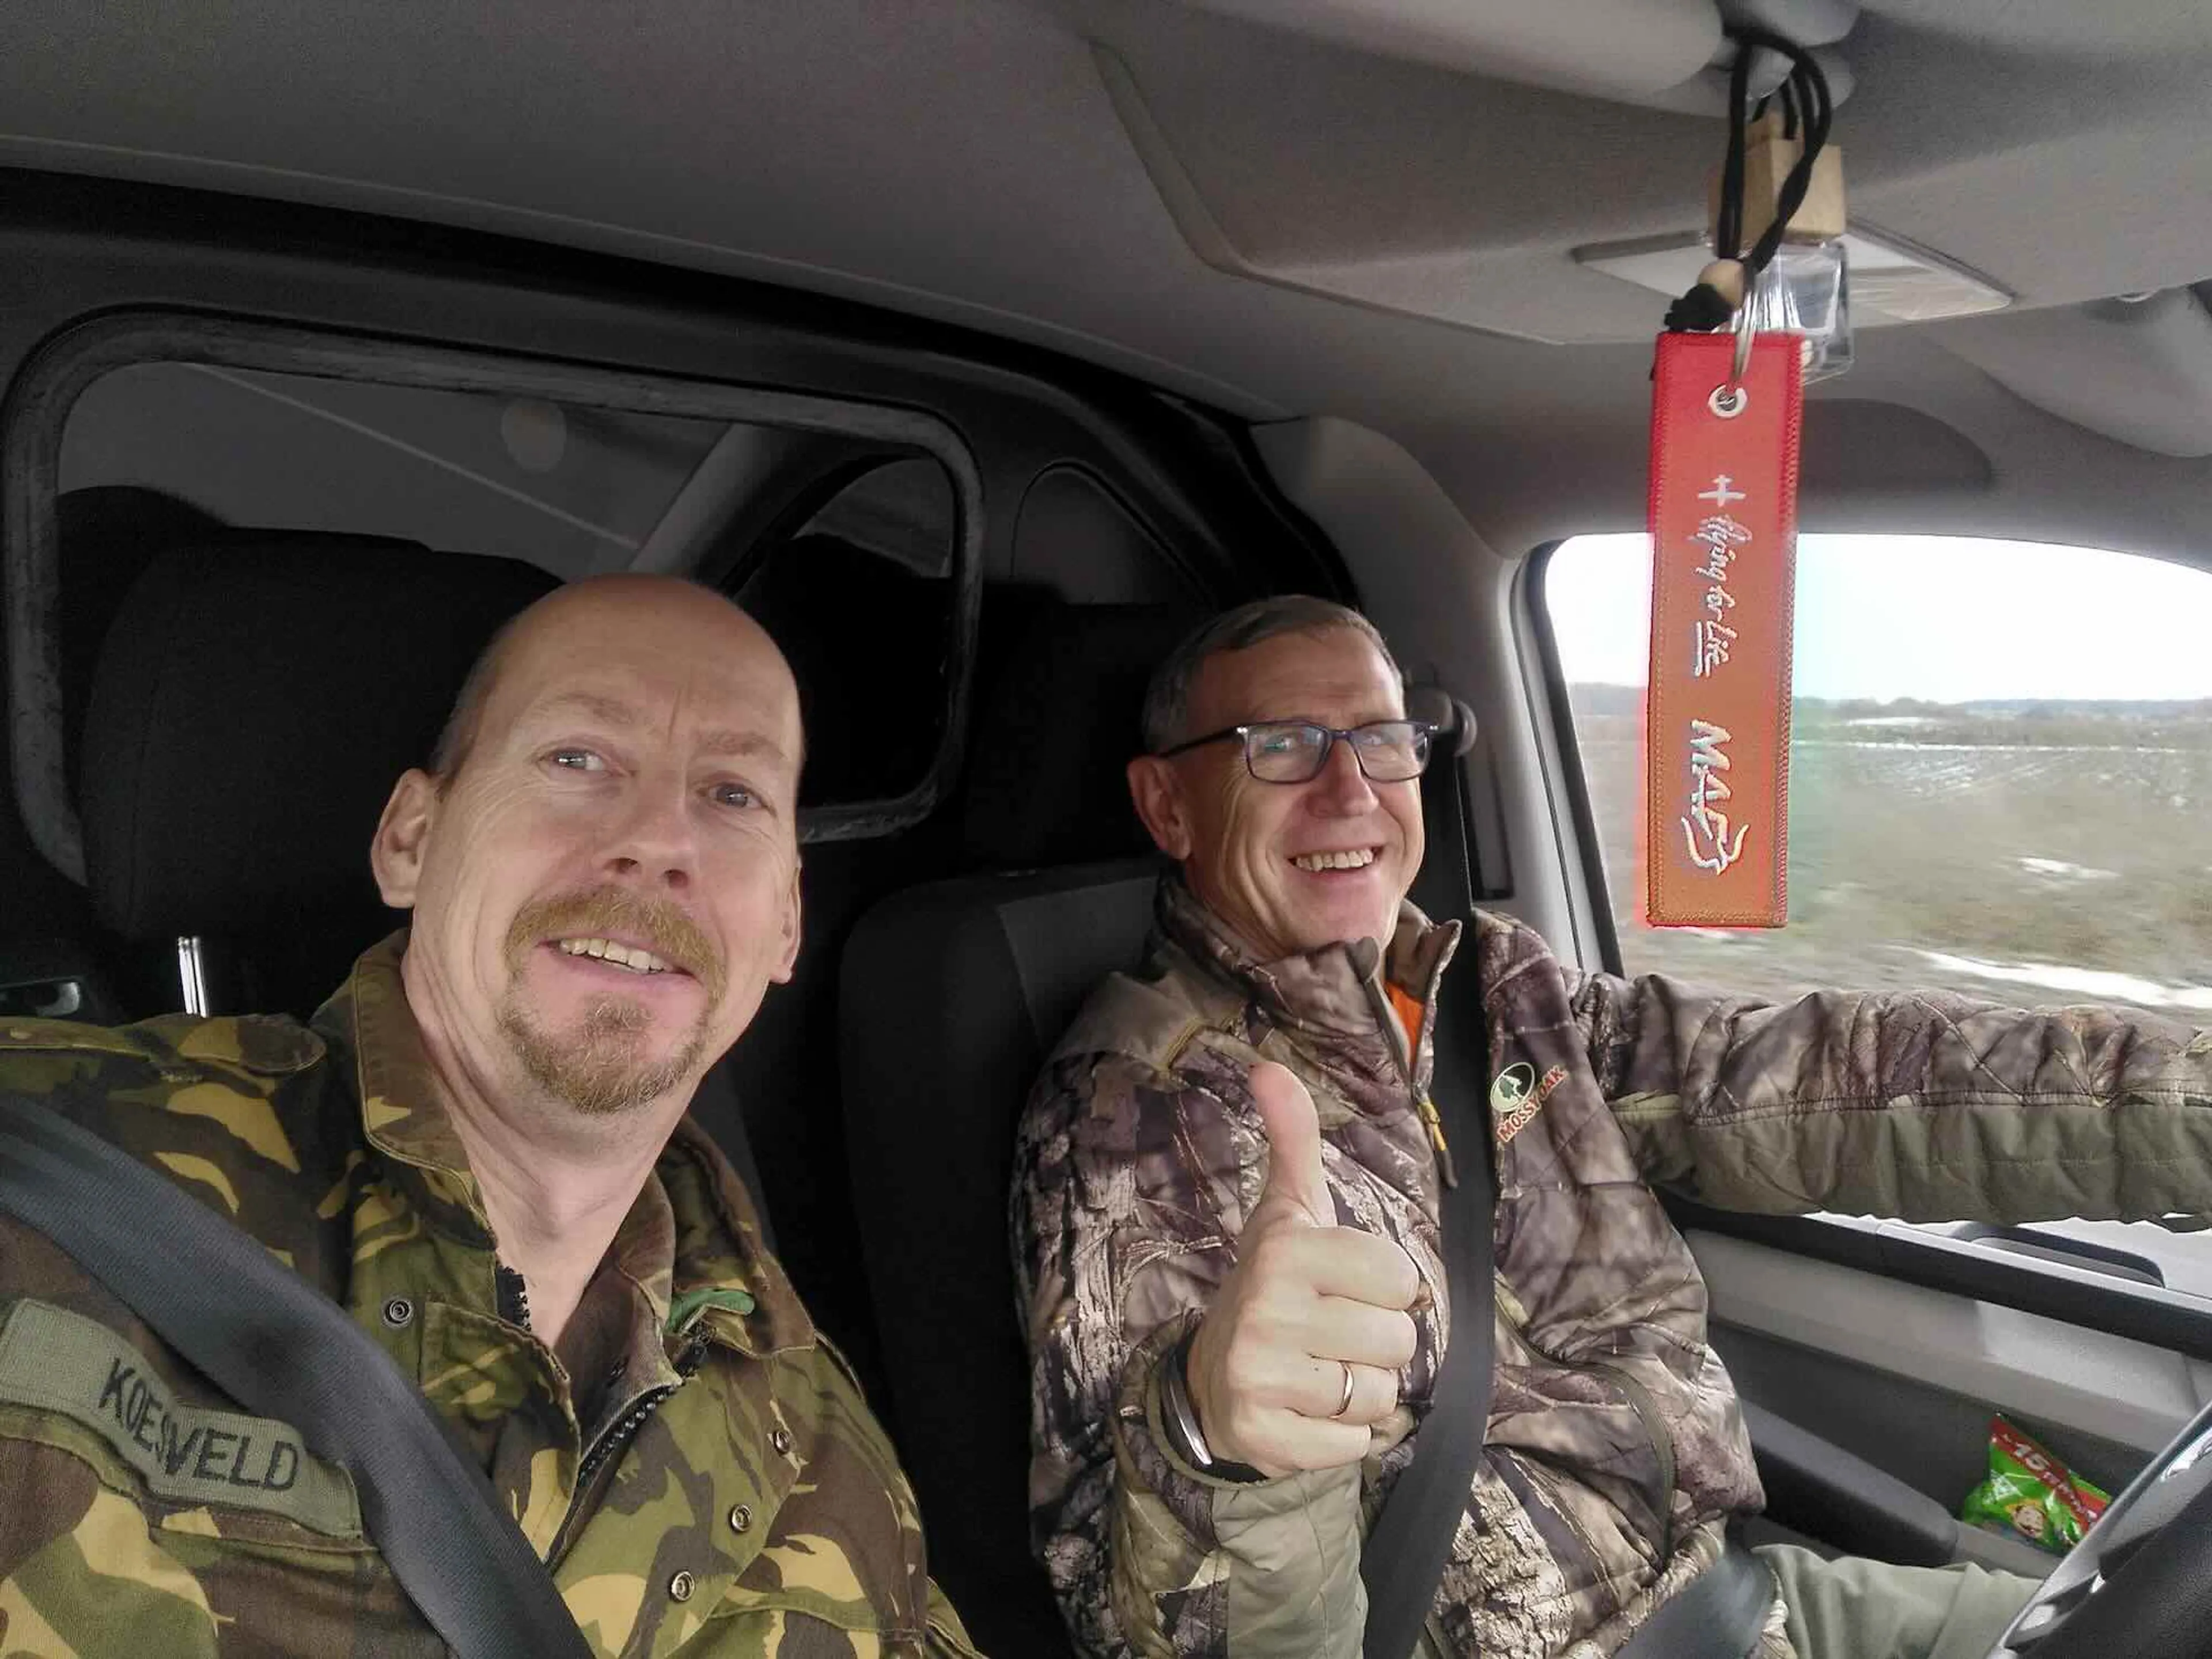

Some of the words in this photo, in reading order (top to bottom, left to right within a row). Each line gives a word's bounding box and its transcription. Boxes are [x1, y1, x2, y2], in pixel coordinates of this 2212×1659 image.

[1706, 584, 1736, 622] for
[1497, 1091, 1542, 1143] MOSSY
[1537, 1065, 1570, 1101] OAK
